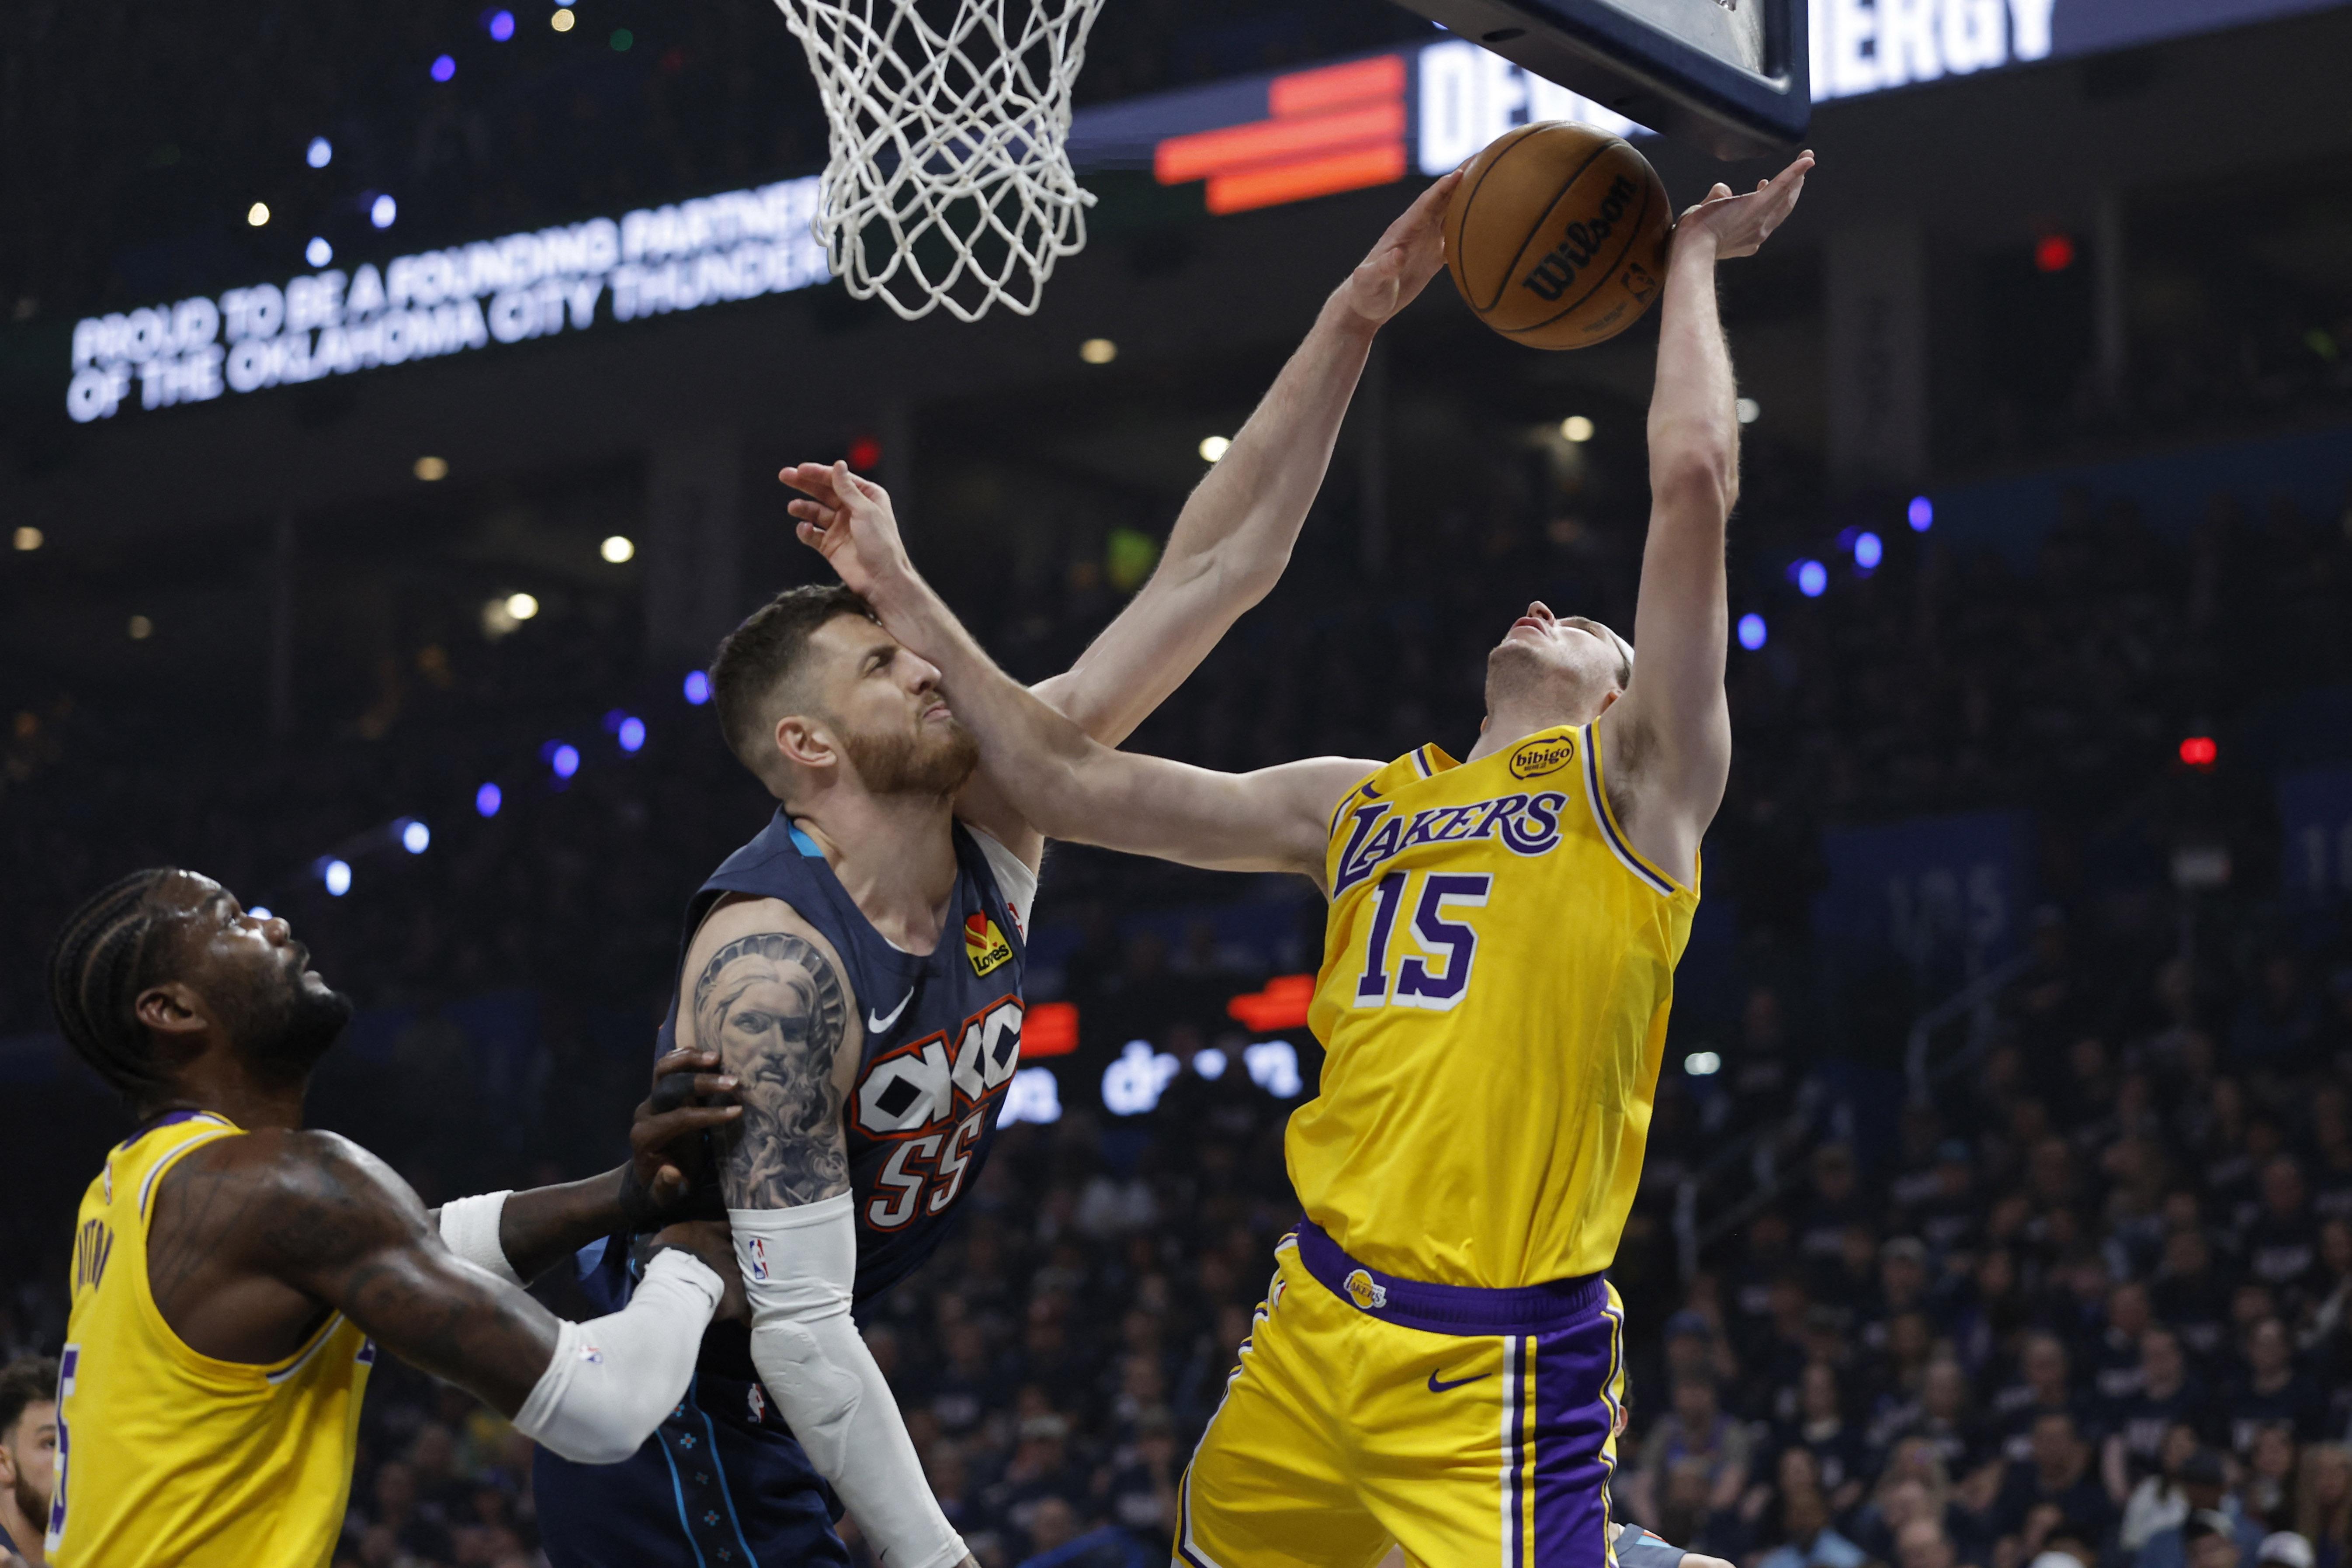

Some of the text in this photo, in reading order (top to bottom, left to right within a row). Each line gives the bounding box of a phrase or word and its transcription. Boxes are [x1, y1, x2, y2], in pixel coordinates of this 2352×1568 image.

[72, 296, 220, 373] PROUD
[219, 283, 284, 343] TO
[285, 269, 348, 335] BE
[348, 263, 387, 318] A
[386, 217, 619, 308] FOUNDING
[1522, 176, 1638, 301] Wilson
[67, 361, 132, 422] OF
[137, 343, 225, 410] THE
[226, 296, 489, 392] OKLAHOMA
[489, 273, 606, 344] CITY
[1516, 748, 1570, 767] bibigo
[1332, 790, 1570, 903] LAKERS
[1353, 871, 1494, 1011] 15
[855, 997, 1023, 1136] OKC
[867, 1108, 988, 1229] 55
